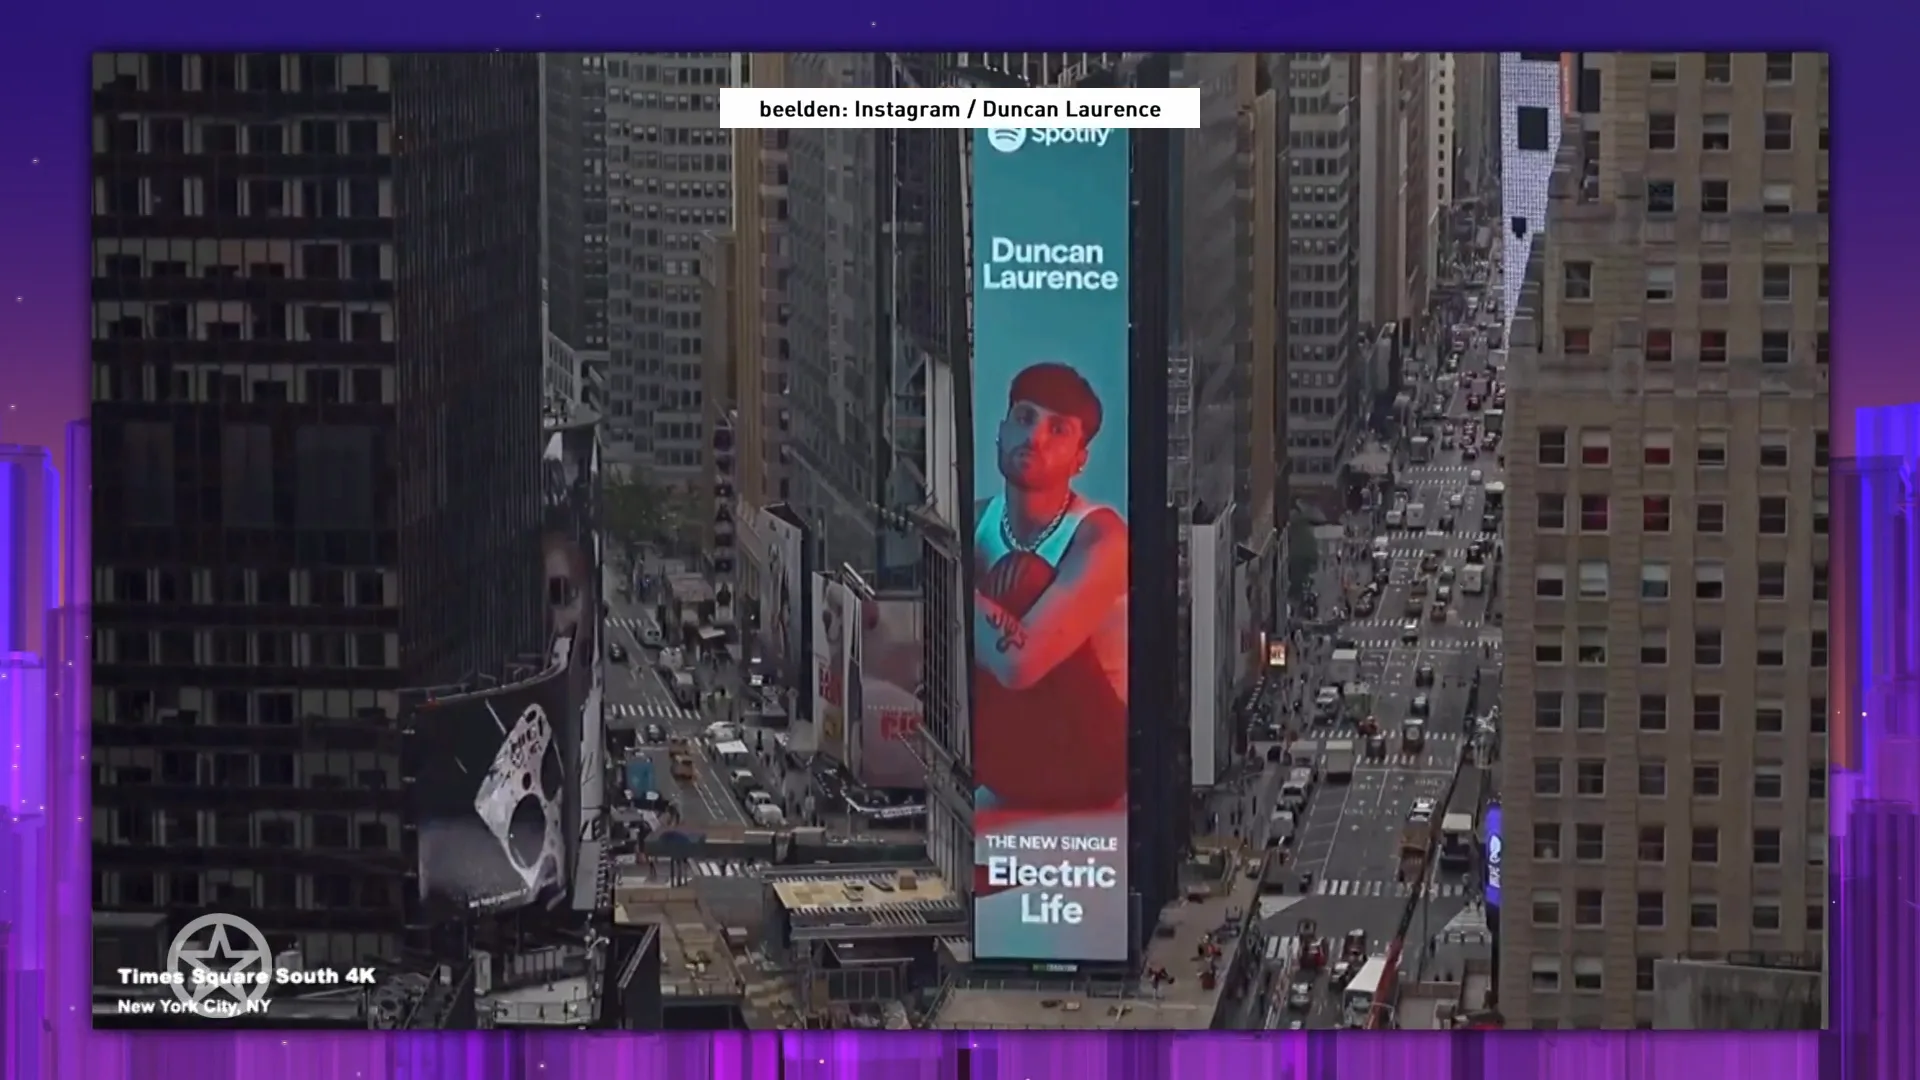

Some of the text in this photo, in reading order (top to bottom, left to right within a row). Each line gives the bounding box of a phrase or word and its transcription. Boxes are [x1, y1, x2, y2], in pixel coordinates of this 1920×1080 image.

[992, 236, 1104, 264] Duncan
[983, 262, 1119, 290] Laurence
[985, 834, 1118, 852] THE NEW SINGLE
[988, 855, 1117, 888] Electric
[1021, 892, 1084, 924] Life
